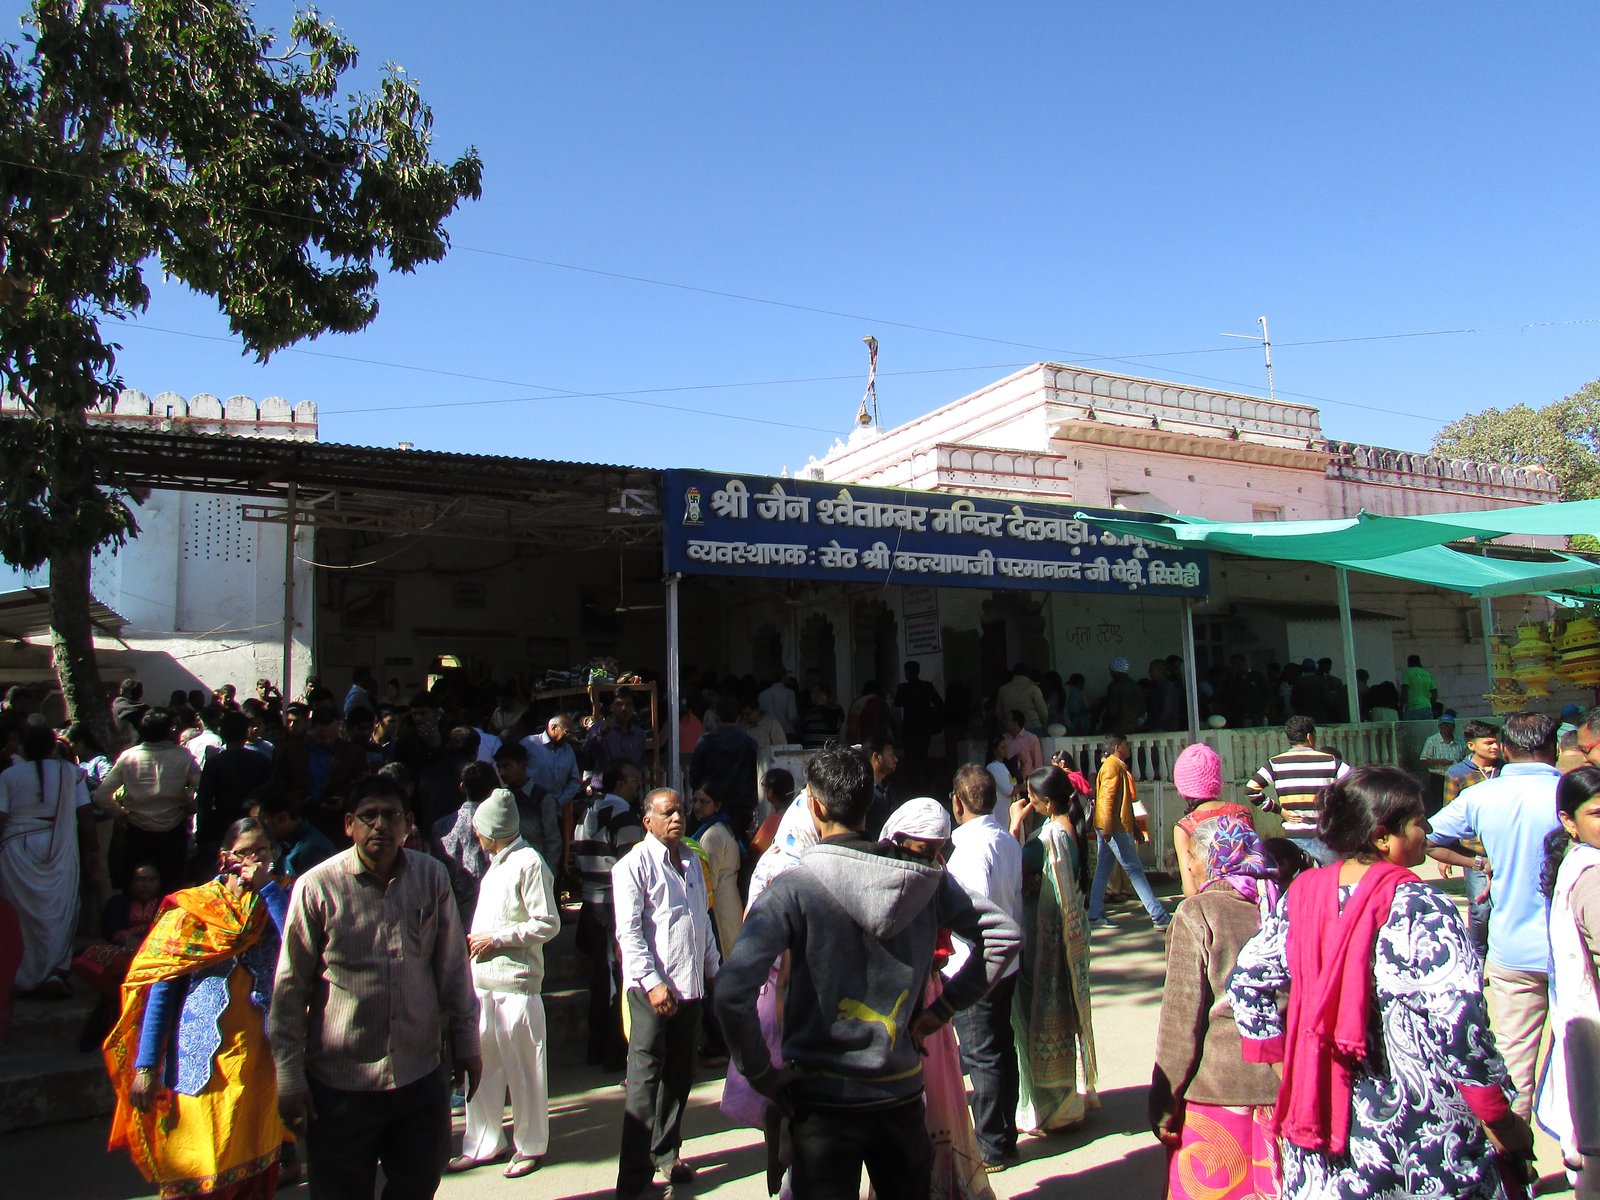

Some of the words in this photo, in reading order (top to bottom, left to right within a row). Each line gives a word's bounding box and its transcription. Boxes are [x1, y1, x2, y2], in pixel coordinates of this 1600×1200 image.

[710, 479, 750, 519] श्री
[754, 482, 811, 524] जैन
[931, 499, 1005, 538] मन्दिर
[818, 540, 859, 569] सेठ
[860, 541, 891, 570] श्री
[893, 549, 995, 576] कल्याणजी
[996, 557, 1082, 580] परमानन्द
[1082, 556, 1111, 583] जी
[1147, 560, 1201, 588] सिरोही
